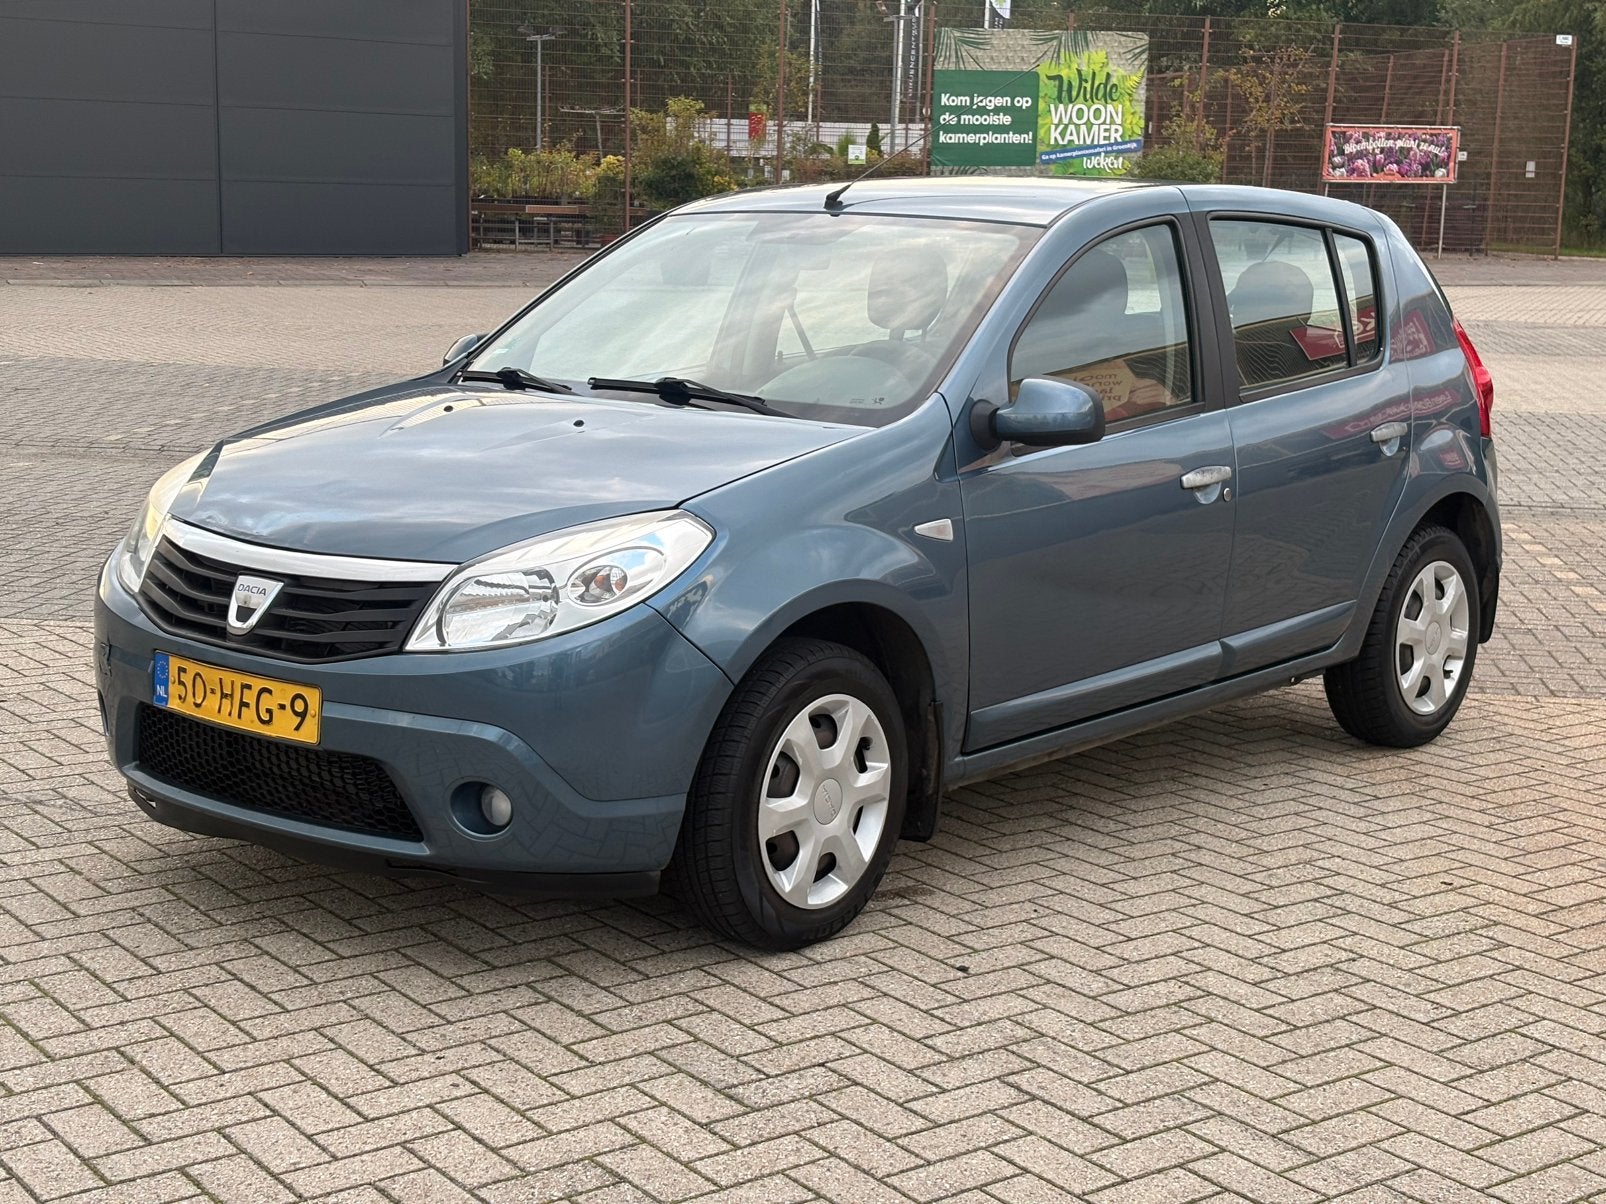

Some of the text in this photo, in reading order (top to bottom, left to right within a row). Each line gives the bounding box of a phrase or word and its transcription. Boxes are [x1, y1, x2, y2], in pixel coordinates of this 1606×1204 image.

[1045, 68, 1118, 104] Wilde
[941, 93, 1032, 109] Kom jagen op
[940, 112, 1012, 125] de mooiste
[1050, 104, 1123, 125] WOON
[939, 131, 1033, 146] kamerplanten!
[1050, 124, 1123, 145] KAMER
[1083, 152, 1124, 173] weken
[237, 583, 267, 596] DACIA
[156, 684, 168, 697] NL
[177, 666, 309, 731] 50-HFG-9
